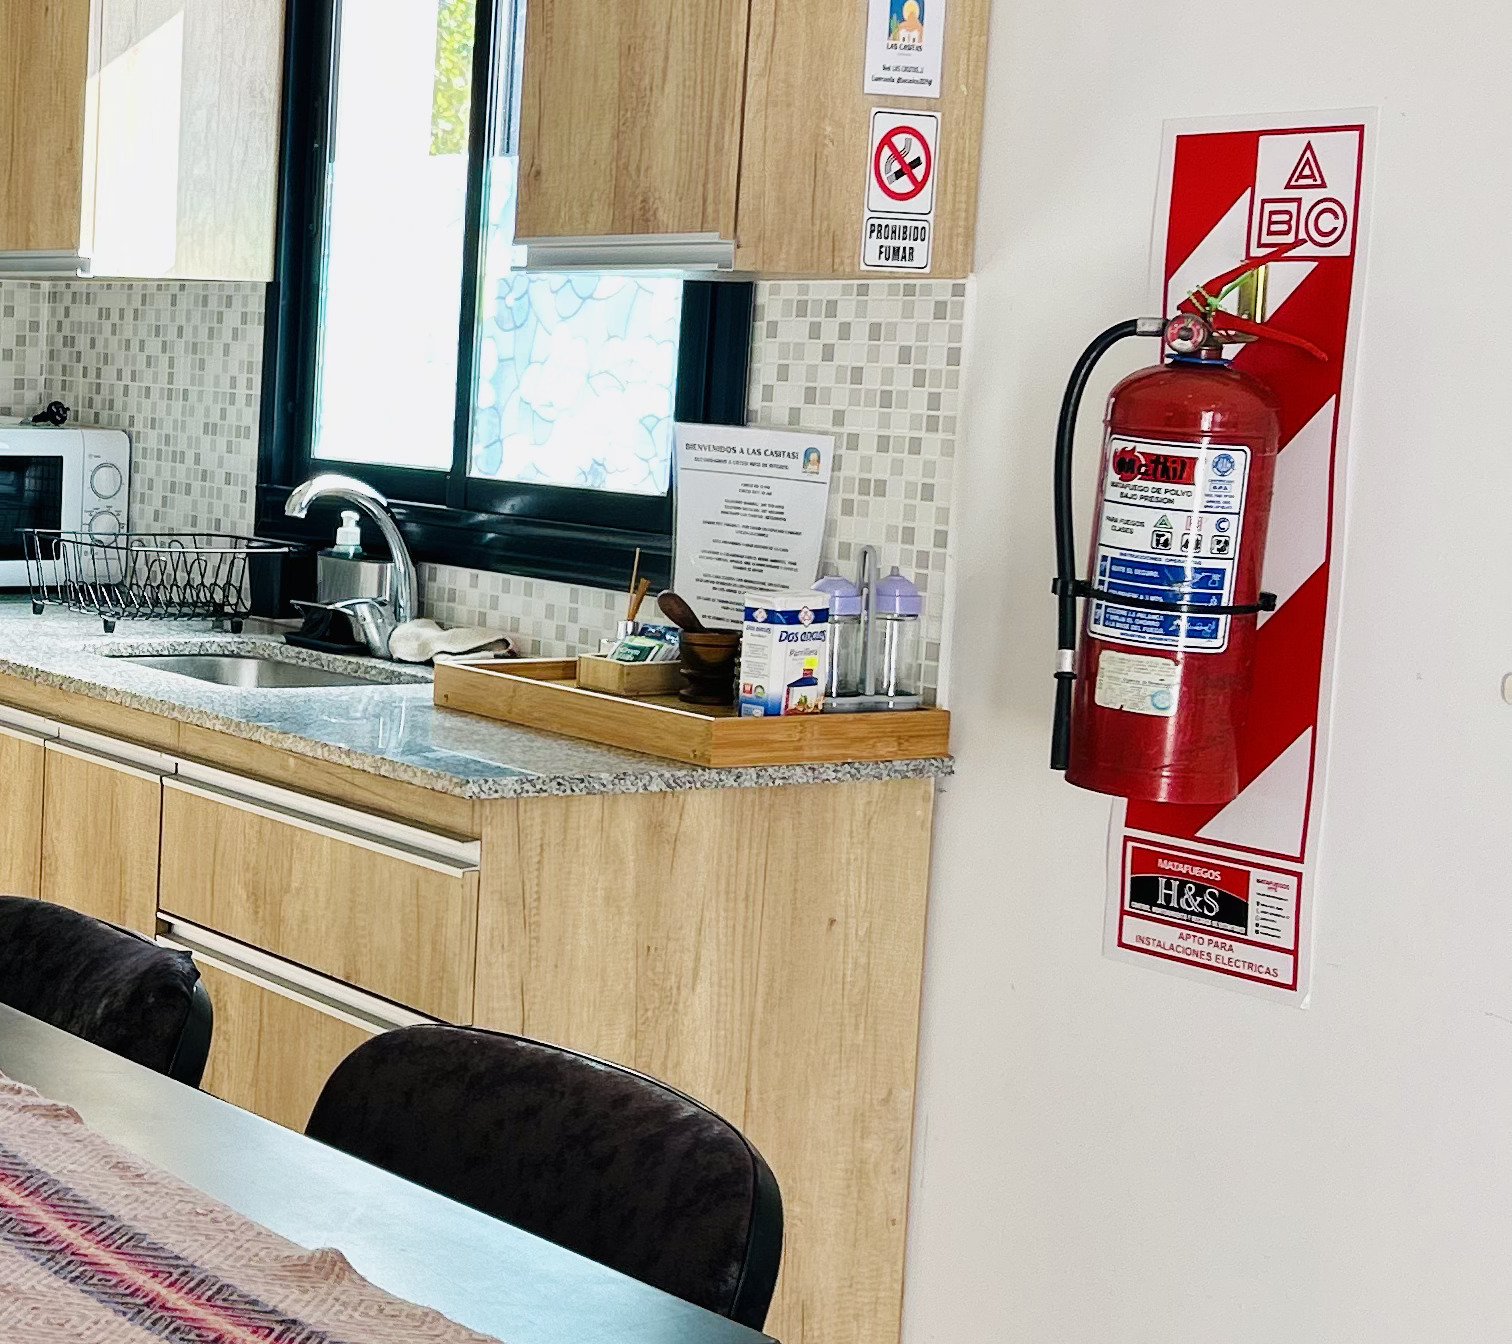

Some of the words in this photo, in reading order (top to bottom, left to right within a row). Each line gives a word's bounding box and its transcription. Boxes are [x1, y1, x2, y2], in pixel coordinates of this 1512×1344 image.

[1294, 156, 1318, 183] A
[869, 223, 927, 242] PROHIBIDO
[1266, 209, 1293, 236] B
[1313, 207, 1340, 238] C
[878, 244, 915, 262] FUMAR
[685, 442, 737, 454] BIENVENIDOS
[738, 447, 745, 455] A
[746, 447, 762, 457] LAS
[1151, 486, 1162, 495] DE
[1164, 488, 1193, 498] POLVO
[1157, 858, 1222, 882] MATAFUEGOS
[1156, 876, 1221, 917] H&S
[1177, 931, 1205, 946] APTO
[1207, 939, 1235, 954] PARA
[1135, 934, 1213, 962] INSTALACIONES
[1214, 953, 1280, 978] ELECTRICAS
